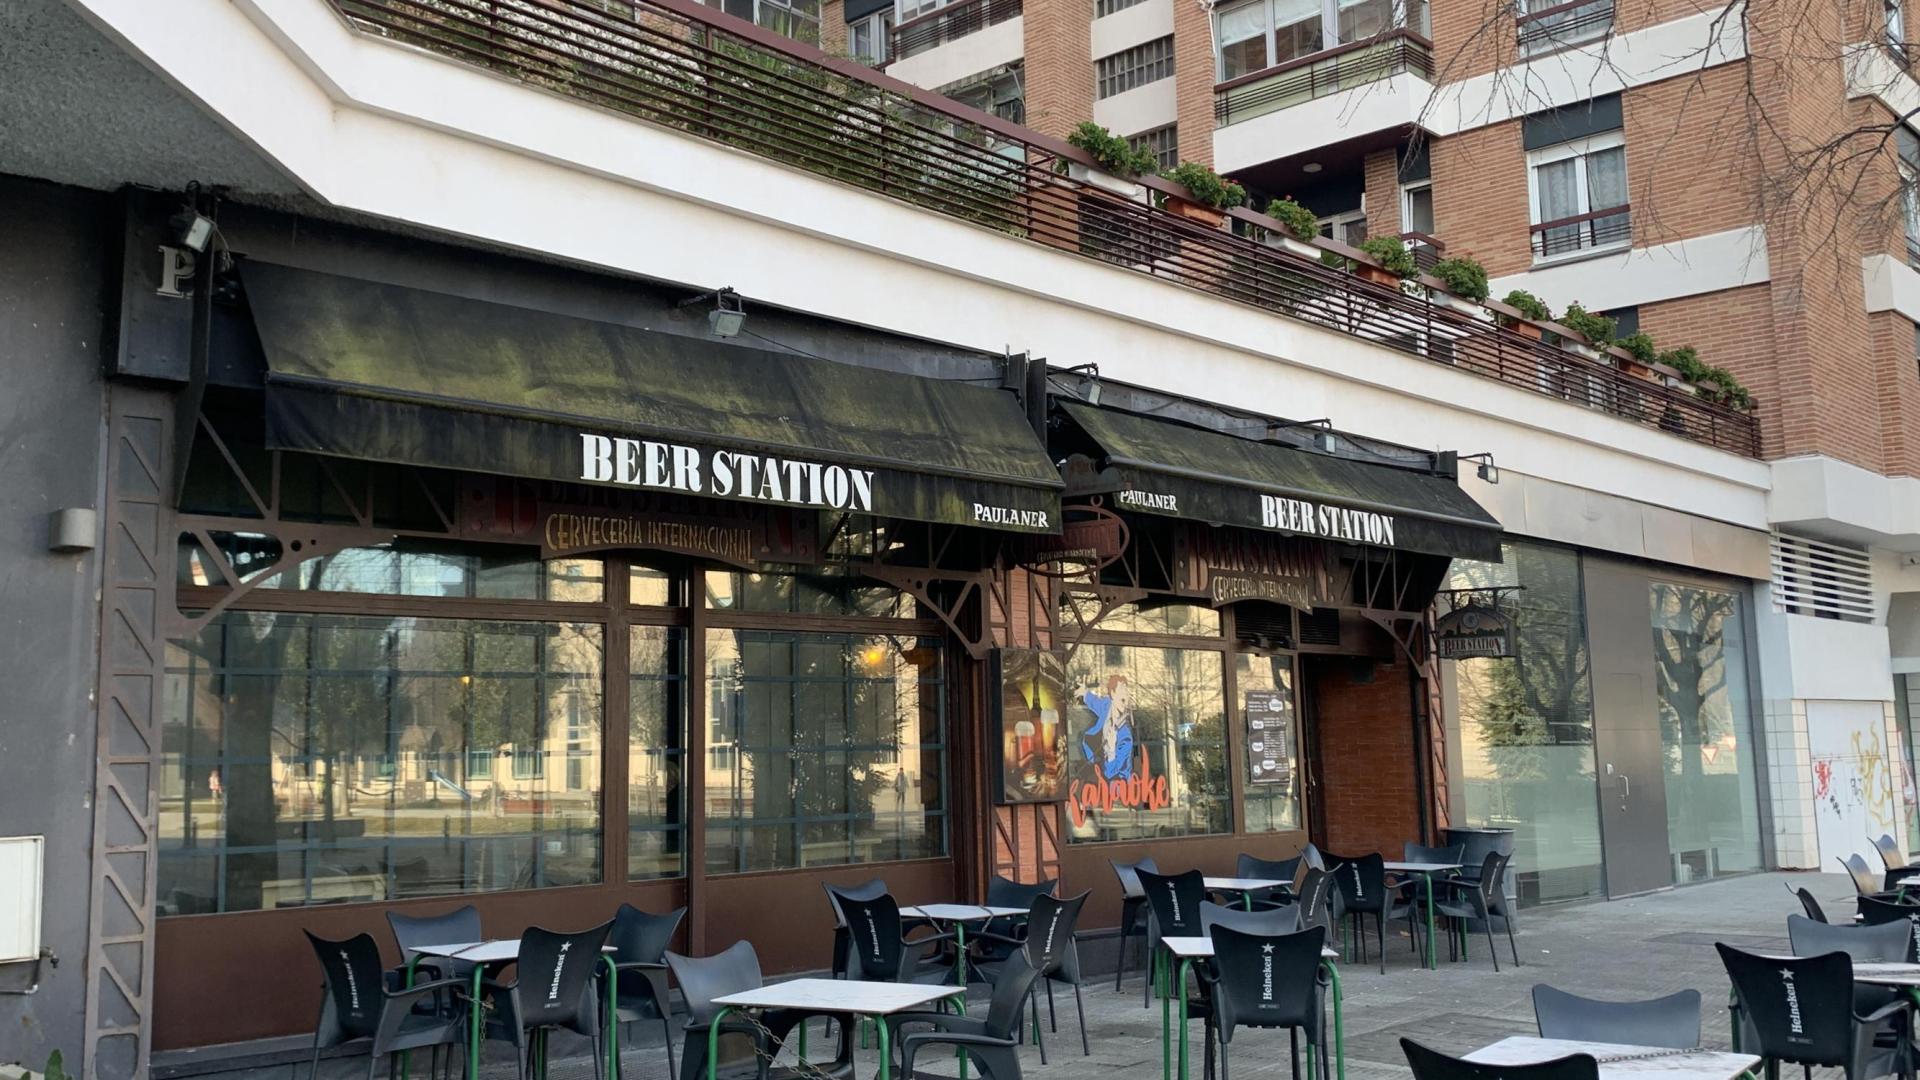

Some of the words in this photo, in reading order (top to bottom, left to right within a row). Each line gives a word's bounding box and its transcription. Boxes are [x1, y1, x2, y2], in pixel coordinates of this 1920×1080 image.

[580, 433, 702, 492] BEER
[711, 450, 874, 511] STATION
[973, 503, 1049, 528] PAULANER
[1120, 489, 1178, 511] PAULANER
[1260, 494, 1316, 534] BEER
[1319, 504, 1395, 546] STATION
[647, 520, 755, 564] INTERNACIONAL
[549, 954, 566, 999] Heineken
[1262, 955, 1273, 1000] Heineken
[1785, 981, 1803, 1034] Heineken
